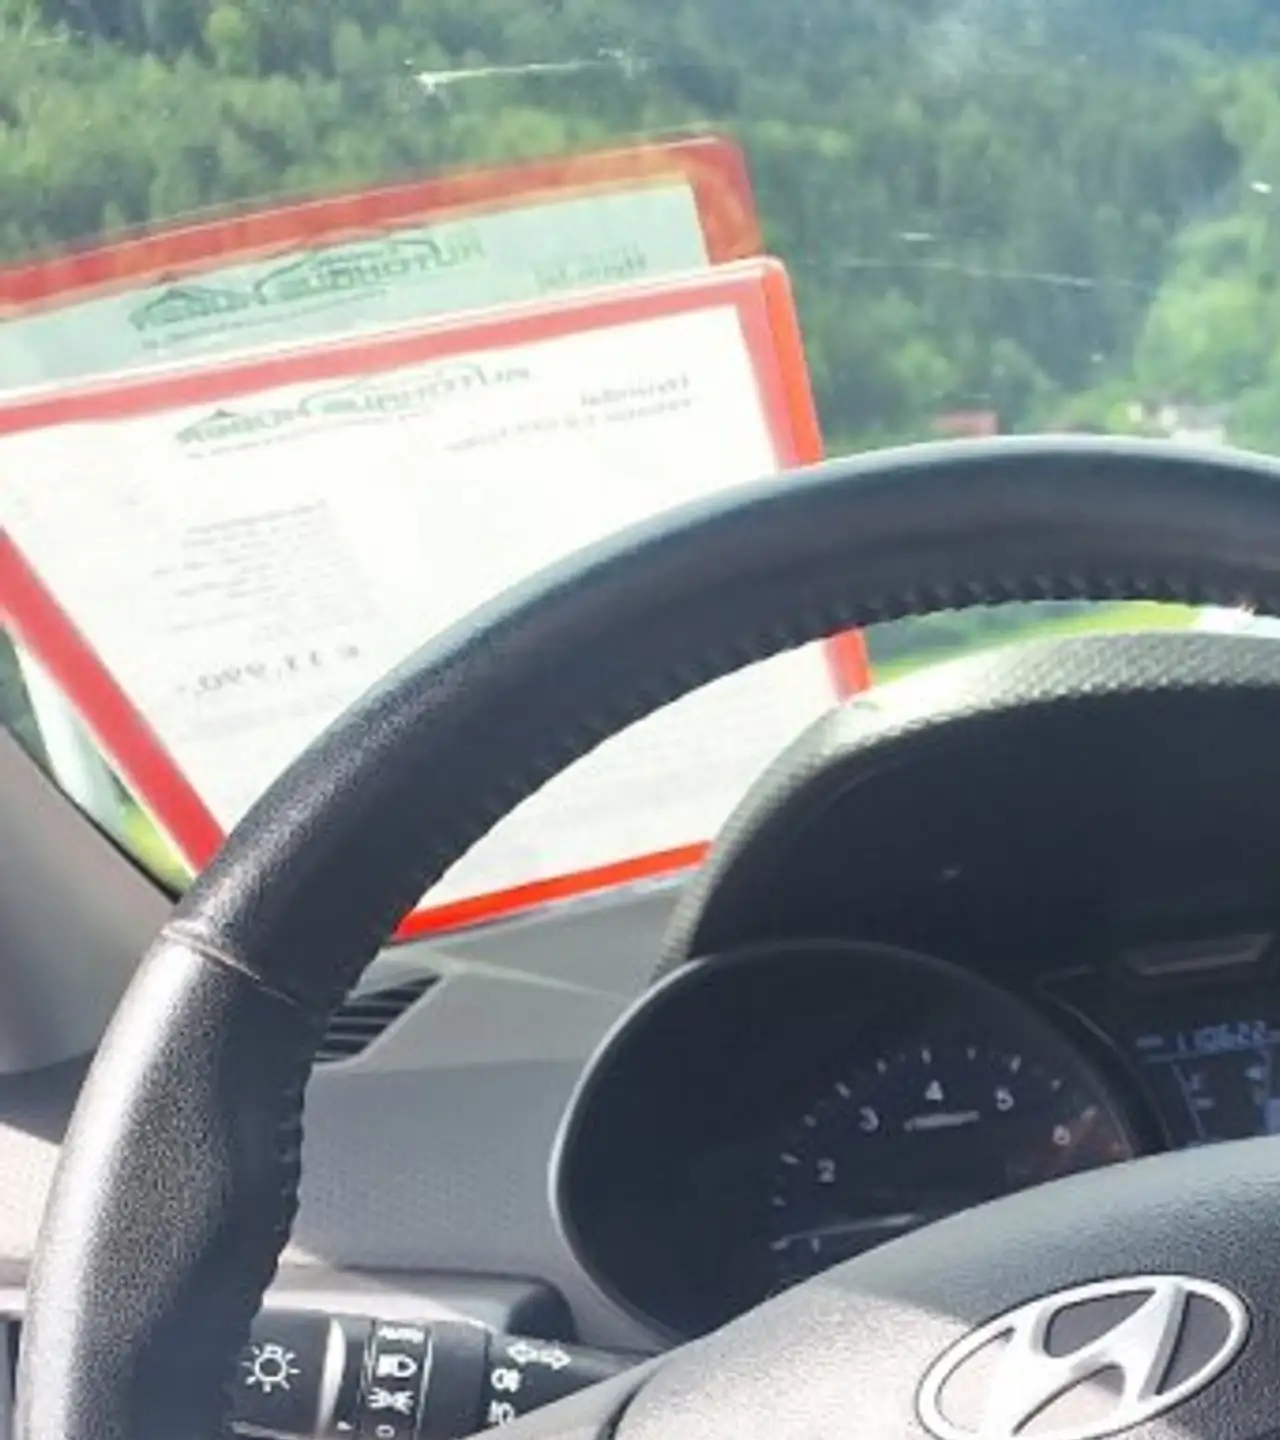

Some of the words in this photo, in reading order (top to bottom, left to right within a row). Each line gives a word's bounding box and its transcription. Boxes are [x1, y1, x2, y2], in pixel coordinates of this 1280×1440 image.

[924, 1079, 946, 1102] 4
[994, 1085, 1016, 1113] 5
[859, 1105, 880, 1133] 3
[815, 1157, 837, 1184] 2
